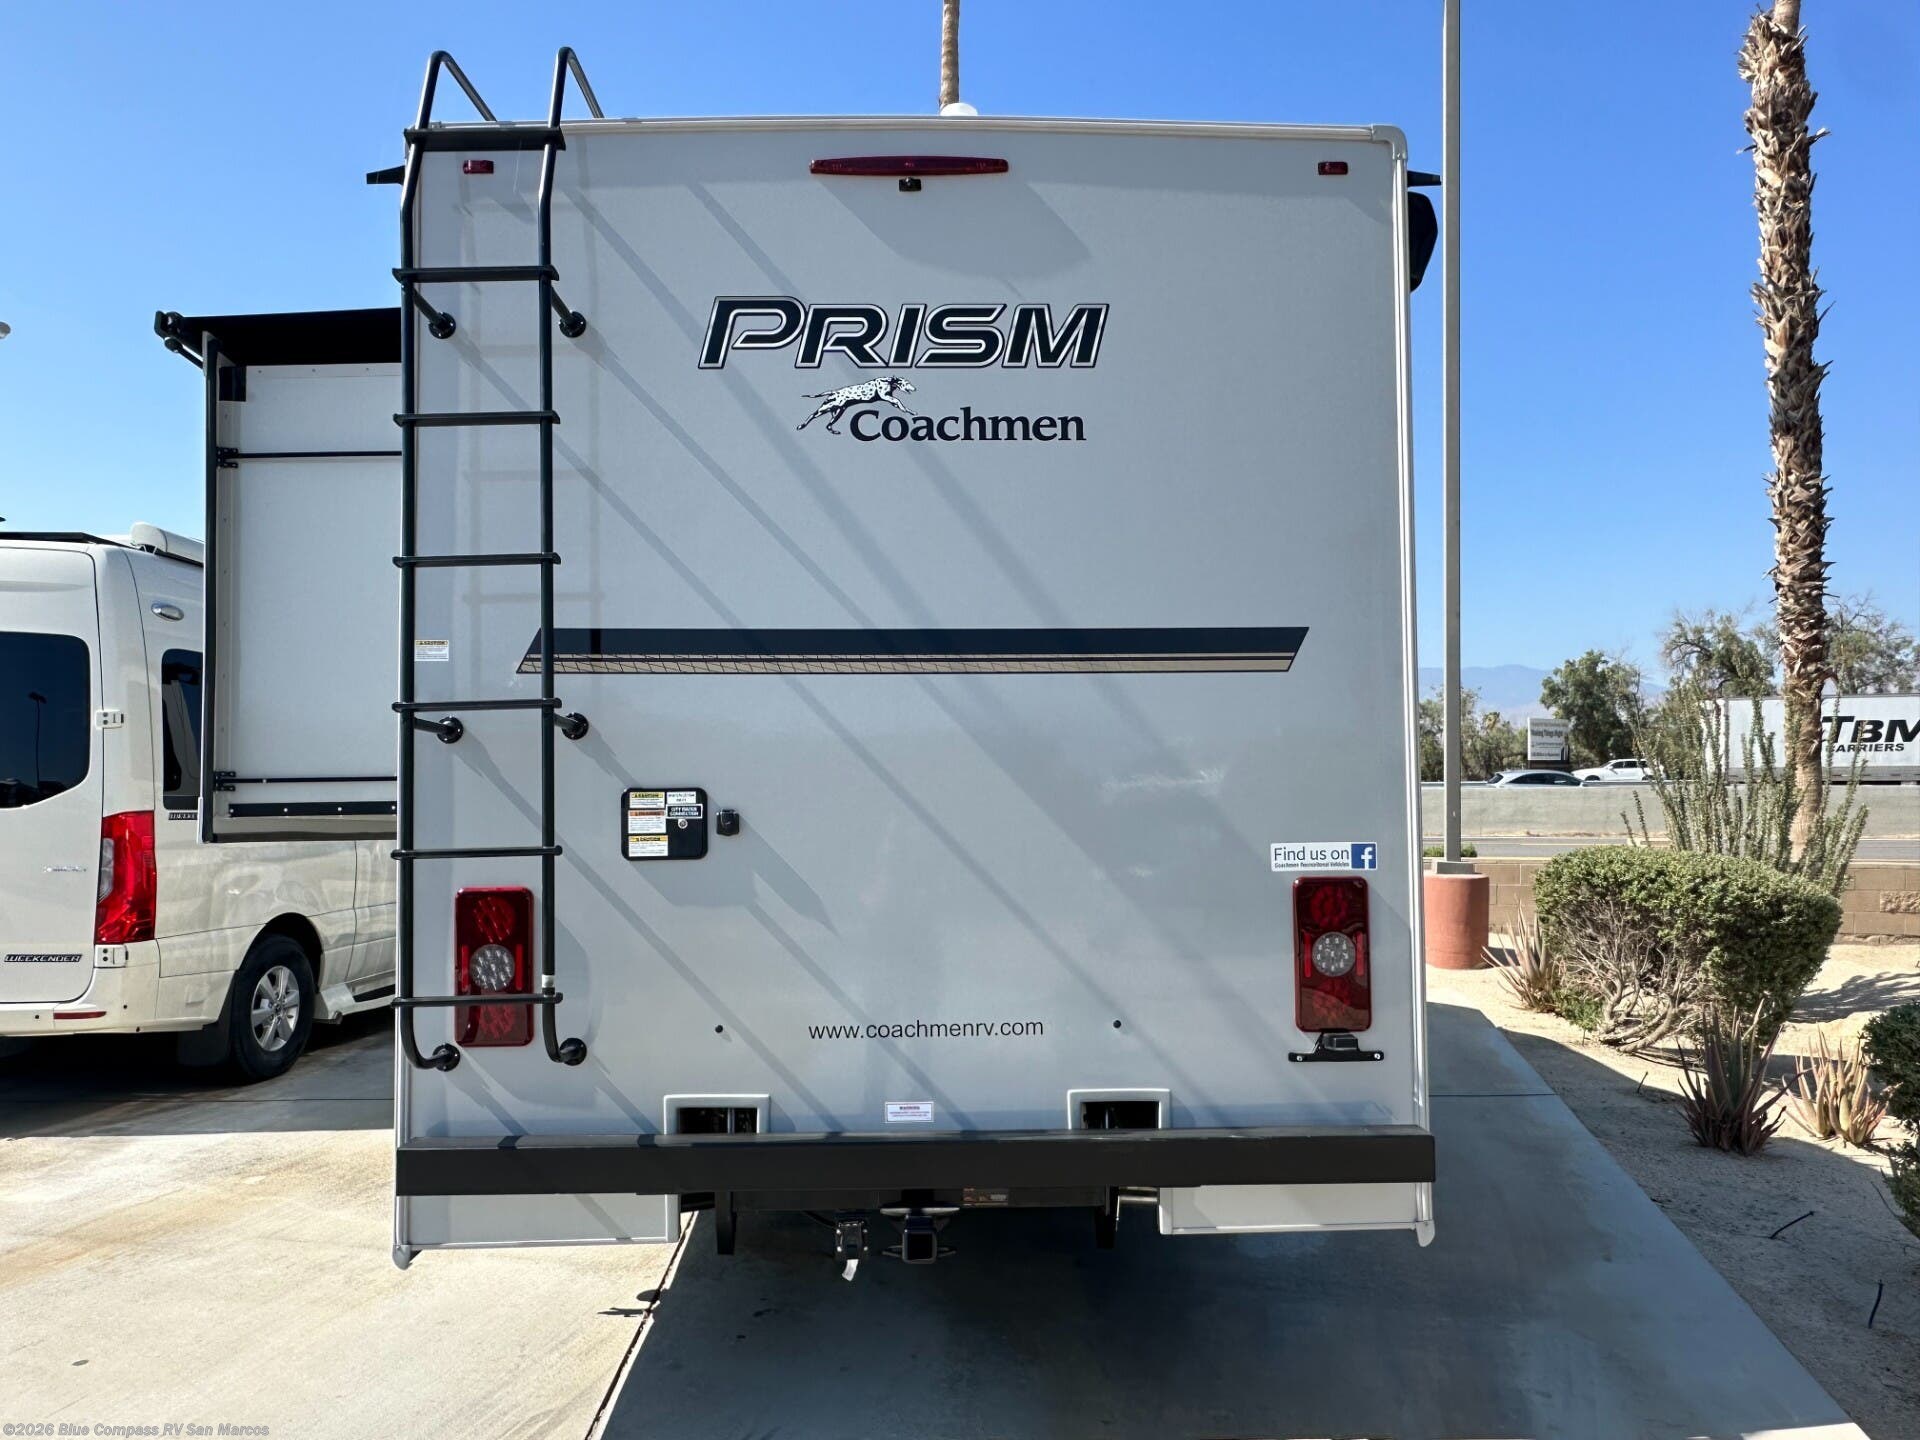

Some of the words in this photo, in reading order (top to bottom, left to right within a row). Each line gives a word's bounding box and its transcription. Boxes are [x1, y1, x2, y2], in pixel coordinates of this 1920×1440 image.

[698, 296, 1109, 368] PRISM
[849, 406, 1087, 442] Coachmen
[1828, 744, 1904, 753] ARRIERS
[1274, 846, 1306, 861] Find
[1310, 849, 1327, 860] us
[1330, 848, 1350, 860] on
[5, 954, 82, 962] WEEKENDER
[808, 1020, 1044, 1039] www.coachmenrv.com
